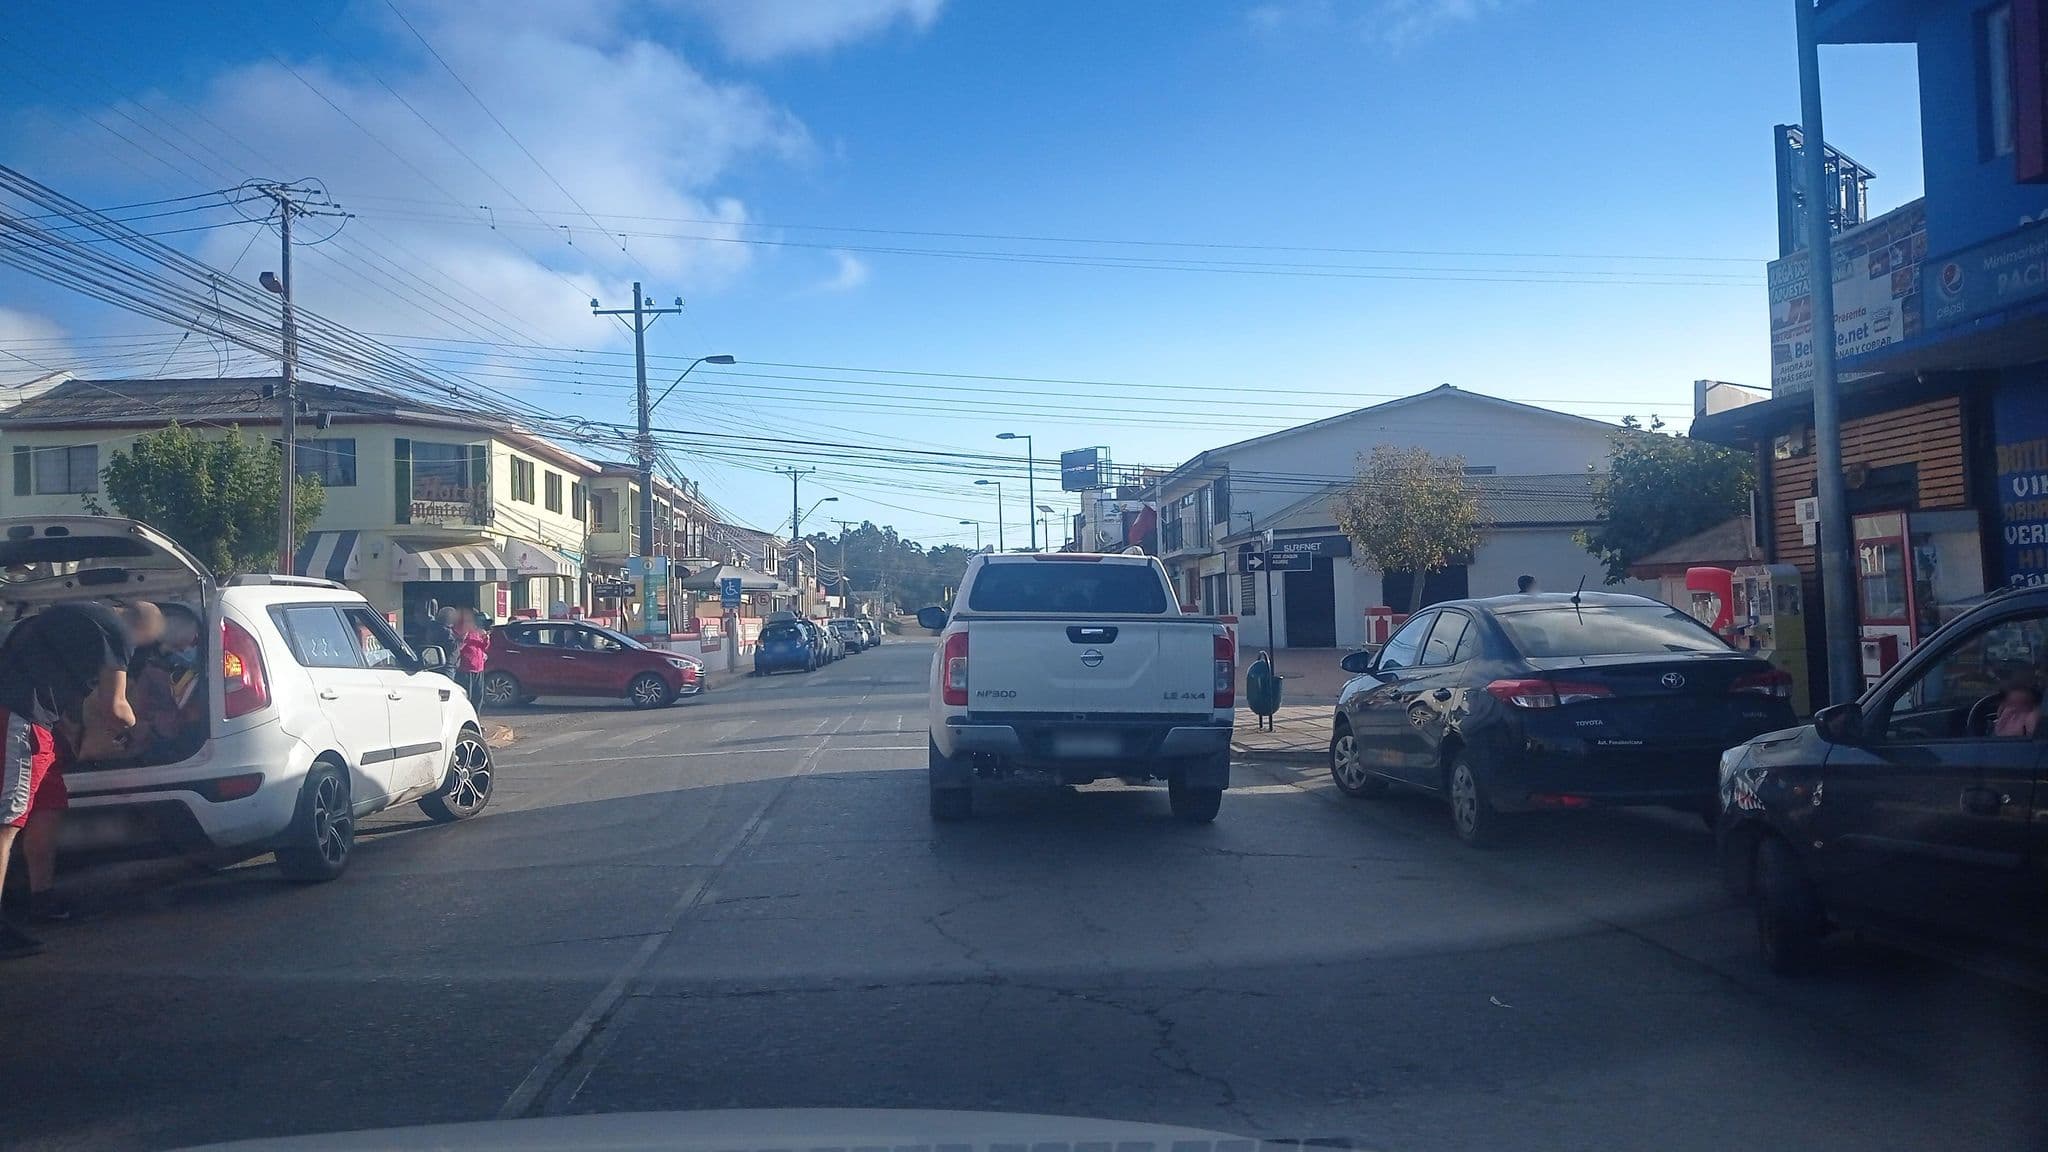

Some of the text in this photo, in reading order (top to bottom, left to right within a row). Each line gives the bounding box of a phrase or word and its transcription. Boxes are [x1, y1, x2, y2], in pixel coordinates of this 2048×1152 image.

[1833, 306, 1867, 322] Presenta
[977, 690, 1017, 698] NP300
[1163, 691, 1178, 700] LE
[1576, 719, 1603, 727] TOYOTA
